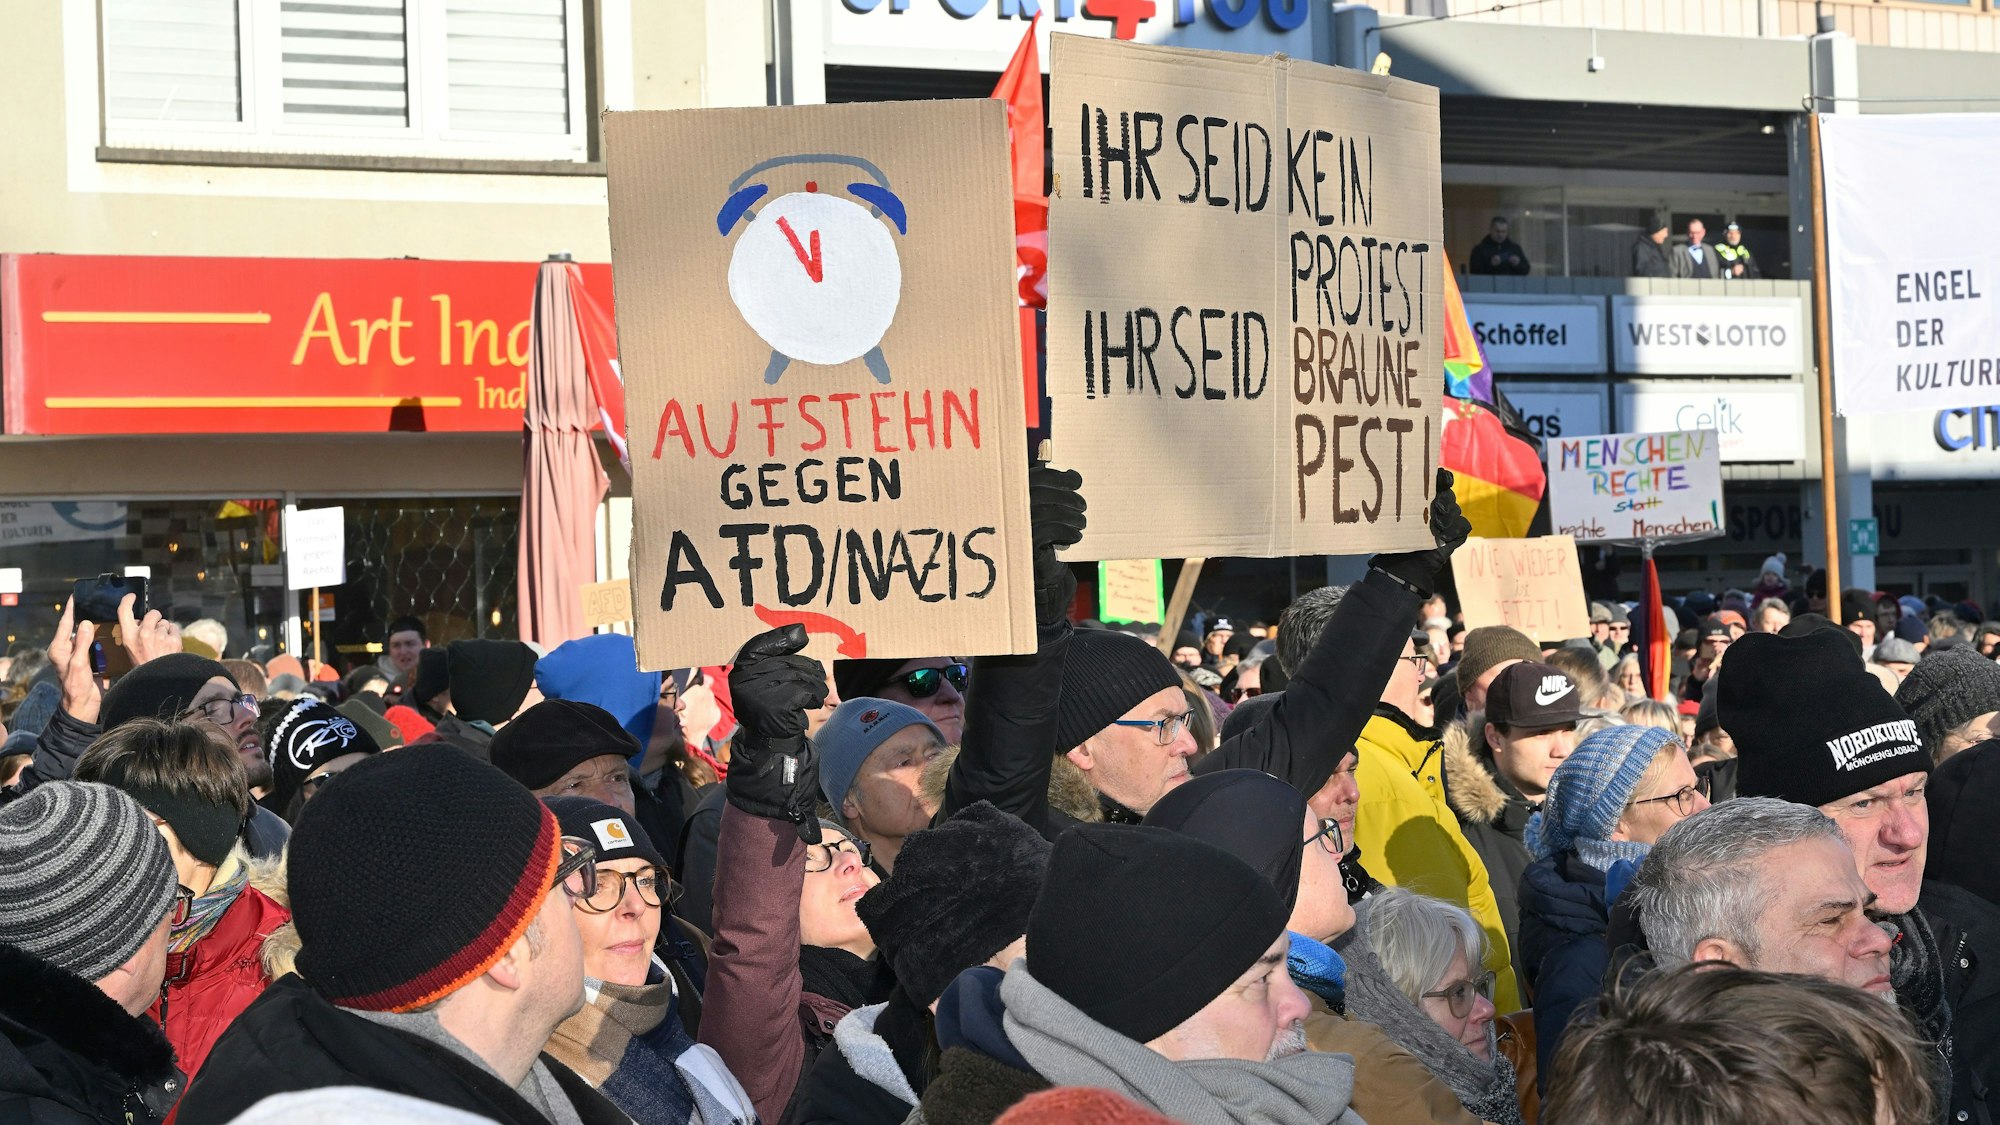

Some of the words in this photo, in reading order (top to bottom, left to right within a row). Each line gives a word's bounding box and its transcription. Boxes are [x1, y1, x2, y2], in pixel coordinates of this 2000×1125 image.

[1081, 103, 1163, 204] IHR
[1176, 114, 1272, 214] SEID
[1287, 127, 1372, 227] KEIN
[1291, 230, 1429, 337] PROTEST
[1897, 269, 1981, 303] ENGEL
[291, 292, 415, 366] Art
[1473, 322, 1567, 345] Schöffel
[1628, 323, 1692, 346] WEST
[1716, 324, 1786, 346] LOTTO
[1897, 318, 1944, 348] DER
[1084, 307, 1162, 399] IHR
[1170, 305, 1269, 400] SEID
[1294, 326, 1422, 408] BRAUNE
[652, 388, 981, 459] AUFSTEHN
[720, 457, 901, 509] GEGEN
[1295, 413, 1431, 525] PEST!
[1588, 465, 1691, 497] RECHTE
[1559, 517, 1606, 539] rechte
[1633, 500, 1720, 538] Menschen!
[1614, 496, 1663, 513] statt
[660, 523, 997, 611] AFD/NAZIS
[1470, 544, 1502, 579] NIE
[1510, 545, 1569, 577] WIEDER
[587, 587, 626, 616] AFD
[1514, 579, 1531, 598] ist
[1542, 674, 1567, 693] NIKE
[1826, 719, 1922, 771] NORDKURVE
[1845, 744, 1919, 771] MÖNCHENGLADBACH
